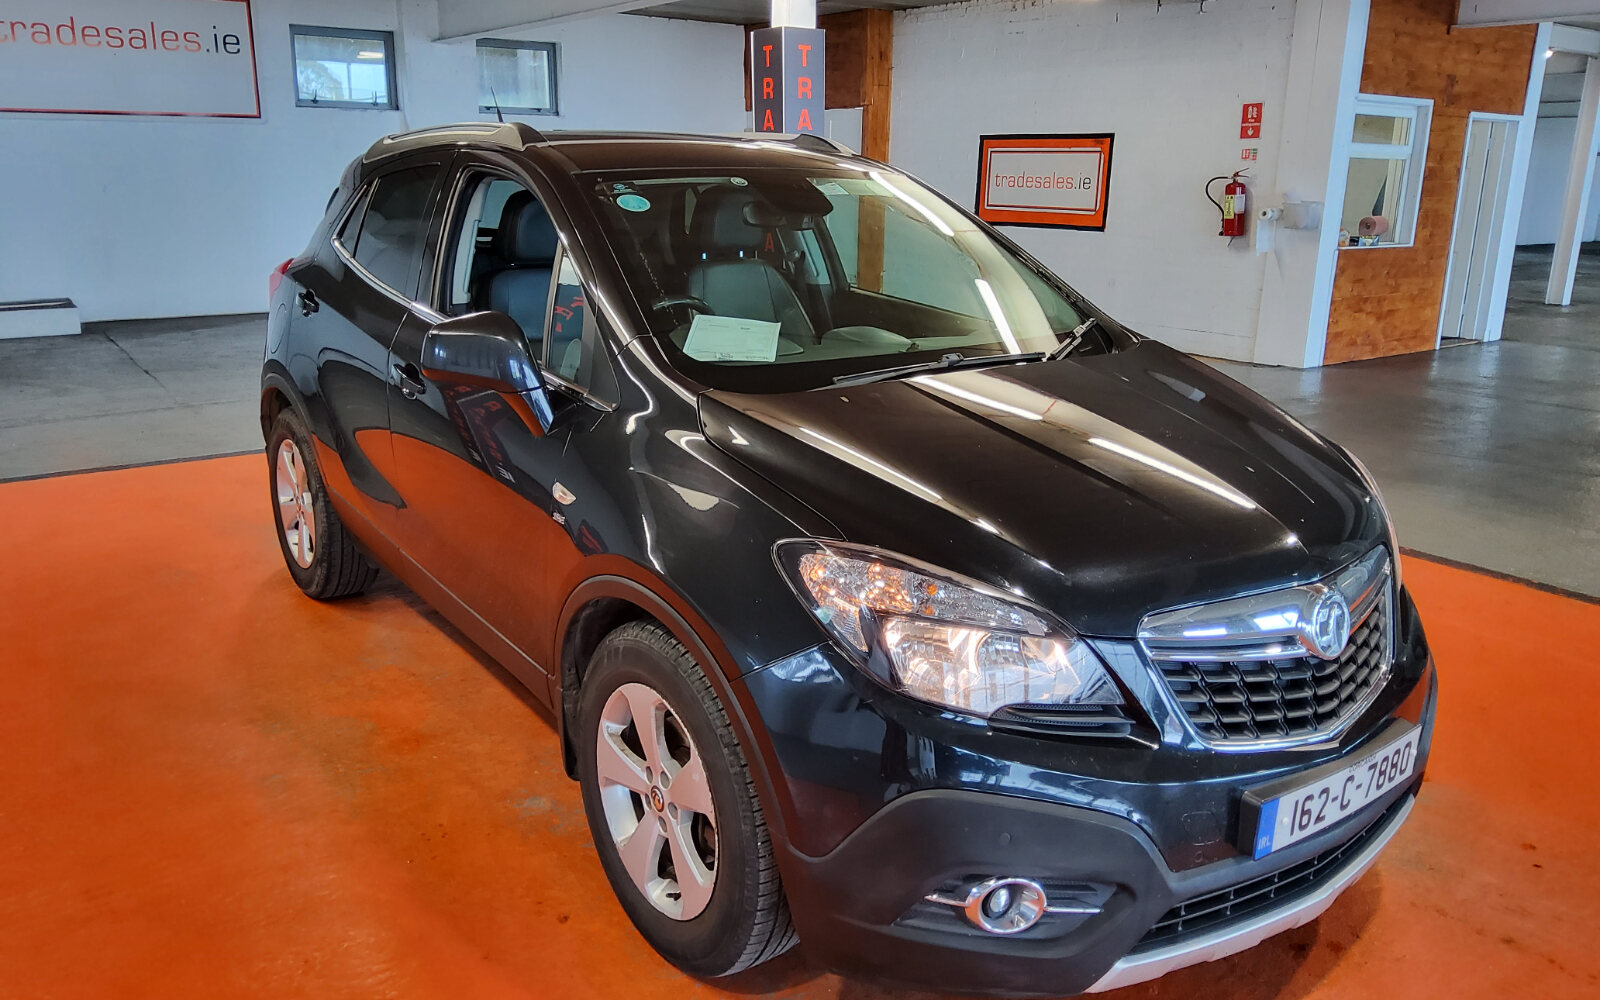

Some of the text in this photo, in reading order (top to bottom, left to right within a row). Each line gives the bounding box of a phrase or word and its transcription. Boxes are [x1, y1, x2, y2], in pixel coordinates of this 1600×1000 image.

[762, 44, 775, 131] TRA
[797, 44, 813, 131] TRA
[994, 171, 1092, 190] tradesales.ie
[1290, 740, 1412, 837] 162-C-7880
[1257, 835, 1271, 850] IRL
